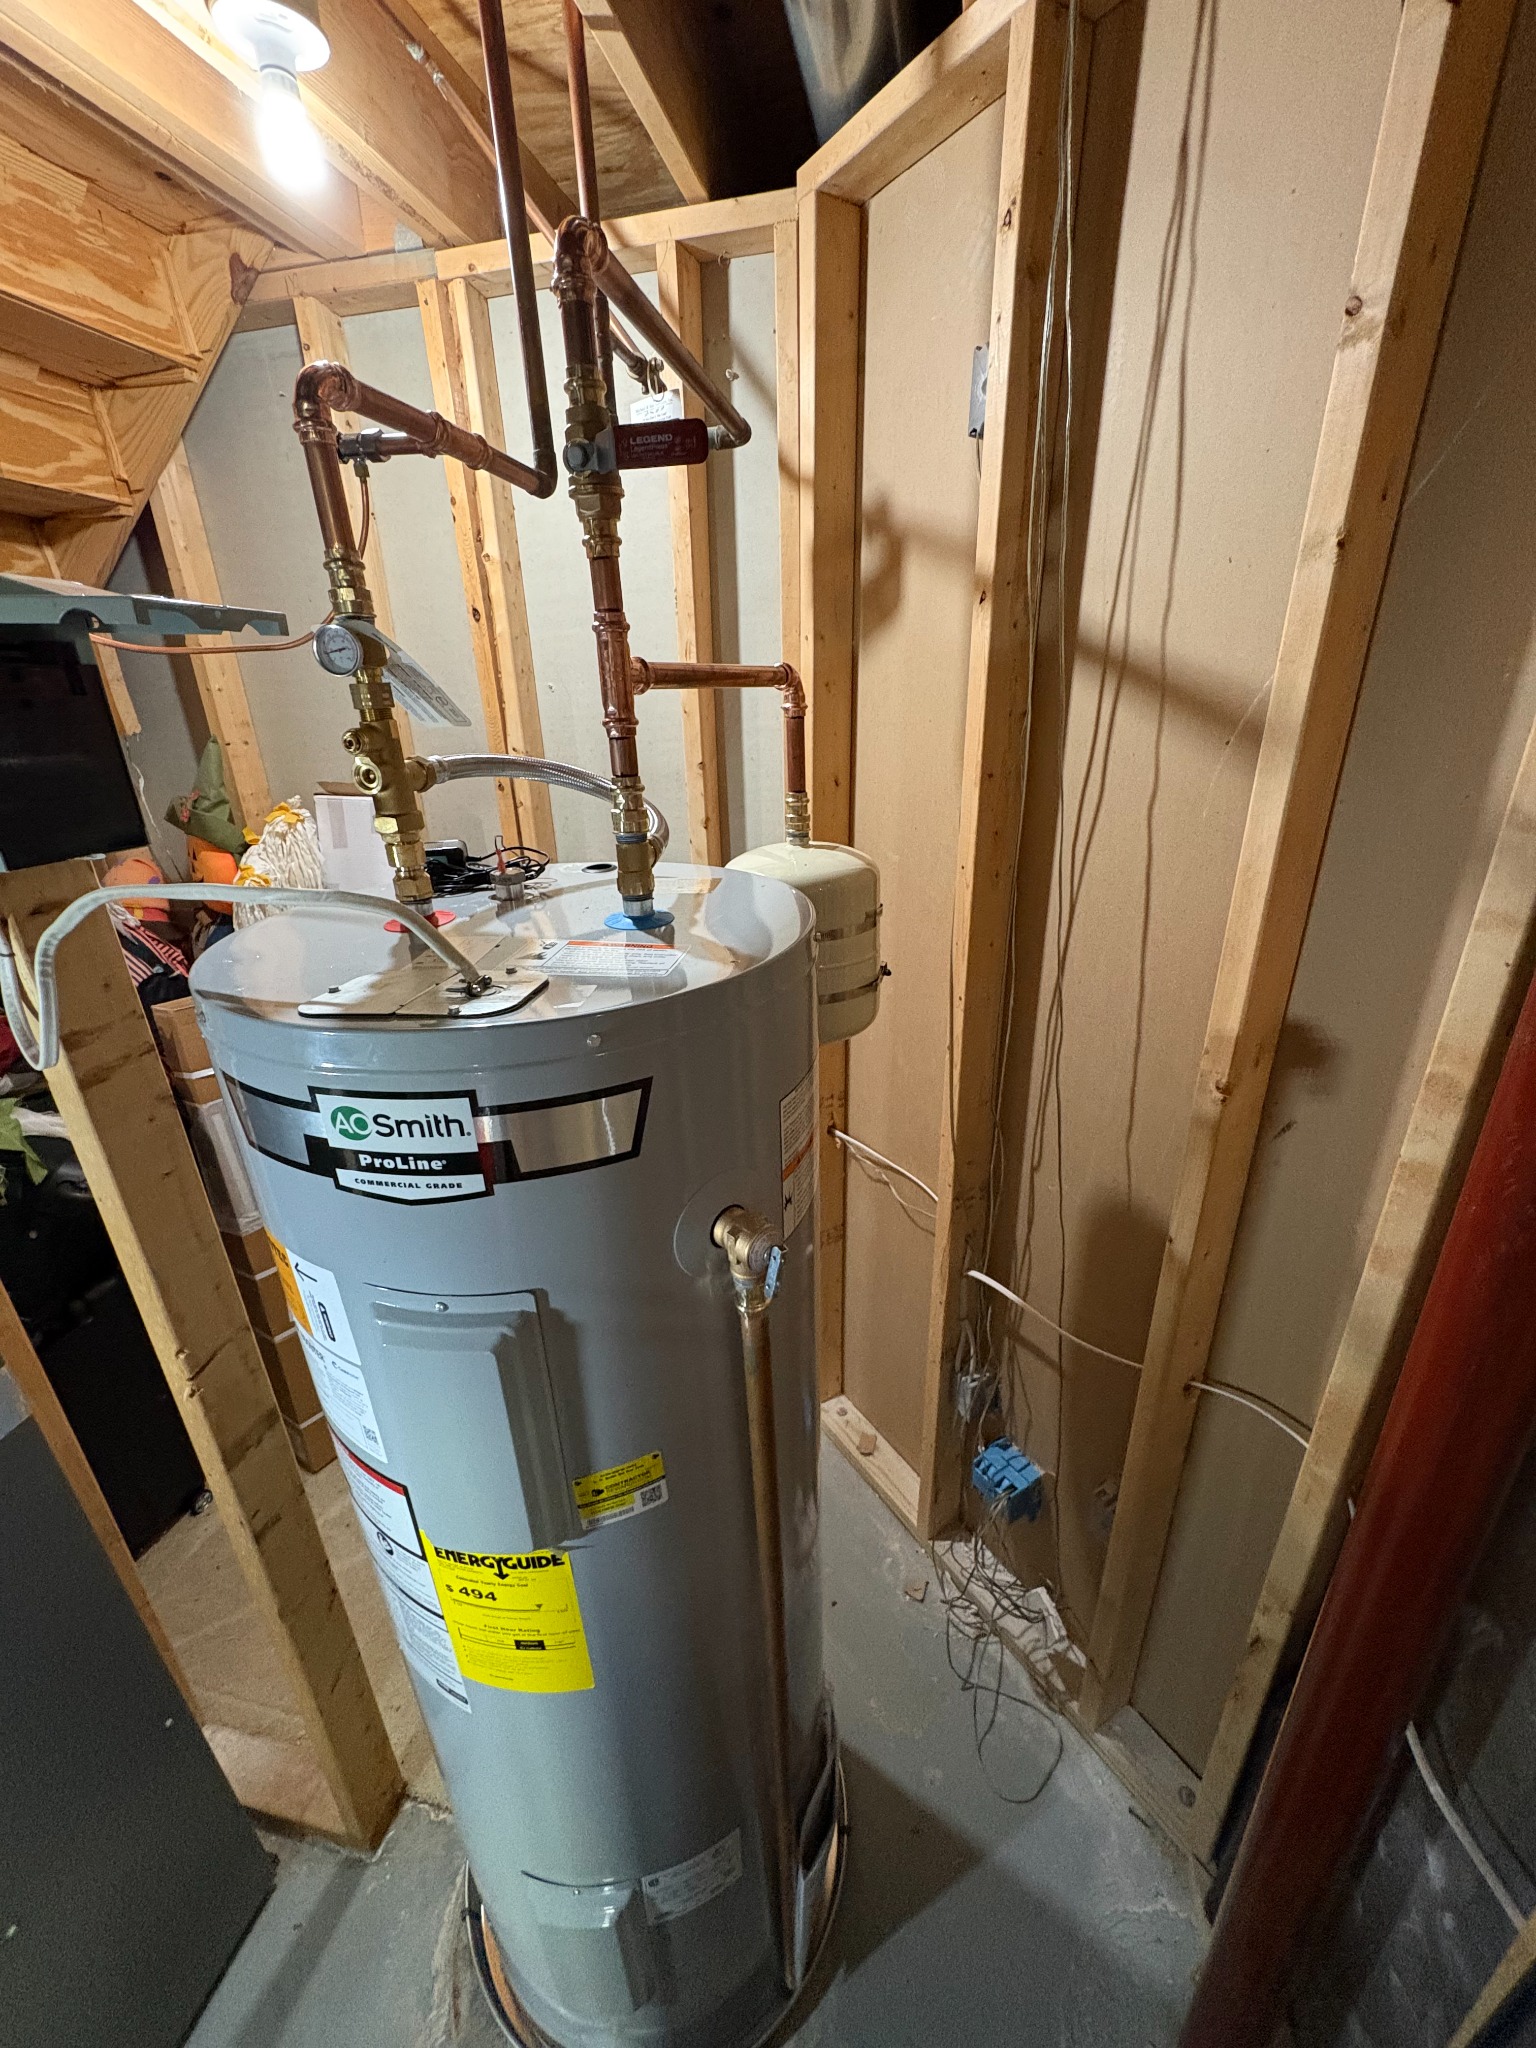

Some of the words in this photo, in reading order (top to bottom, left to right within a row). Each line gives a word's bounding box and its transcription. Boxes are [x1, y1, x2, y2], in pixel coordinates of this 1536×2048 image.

[629, 433, 673, 445] LEGEND
[354, 1177, 421, 1189] COMMERCIAL
[458, 1586, 498, 1602] 494
